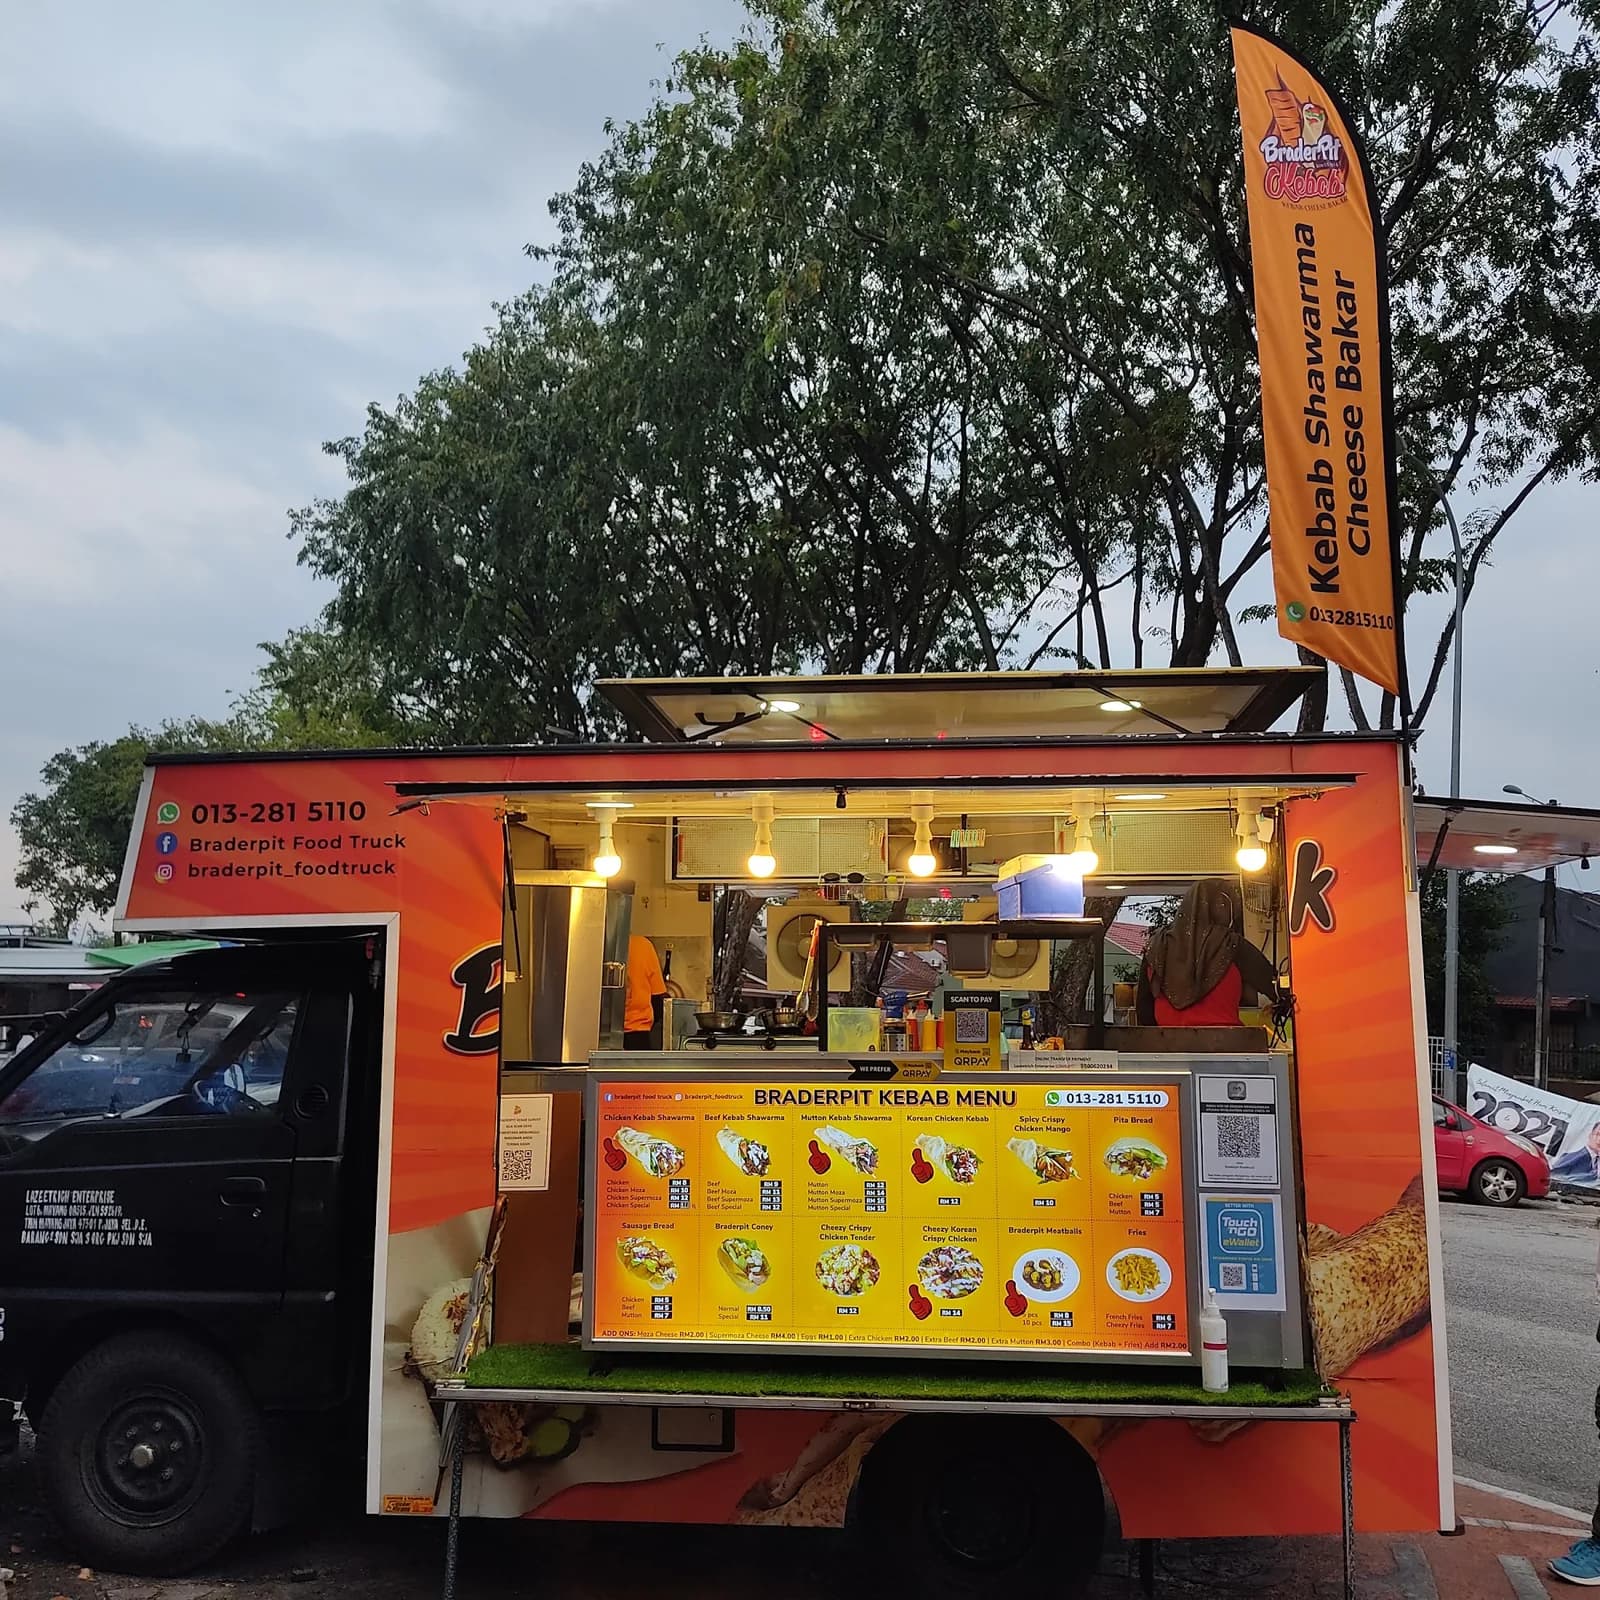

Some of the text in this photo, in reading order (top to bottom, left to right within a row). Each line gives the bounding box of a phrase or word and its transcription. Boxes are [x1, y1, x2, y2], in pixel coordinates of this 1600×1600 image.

[1295, 222, 1339, 593] Kebab Shawarma
[1332, 269, 1371, 556] Cheese Bakar
[1310, 606, 1393, 630] 0132815110
[191, 801, 366, 824] 013-281 5110
[190, 834, 406, 853] Braderpit Food Truck
[188, 860, 395, 879] braderpit_foodtruck
[954, 1057, 990, 1067] QRPAY
[903, 1069, 931, 1078] QRPAY
[754, 1089, 1017, 1106] BRADERPIT KEBAB MENU
[1066, 1093, 1161, 1105] 013-281 5110
[1019, 1116, 1065, 1124] Spicy Crispy
[1472, 1091, 1569, 1157] 2021
[1046, 1126, 1071, 1134] Mango
[715, 1223, 749, 1231] Braderpit
[1222, 1217, 1257, 1227] Touch
[848, 1224, 872, 1232] Crispy
[1008, 1227, 1045, 1235] Braderpit
[922, 1235, 945, 1243] Crispy
[1223, 1238, 1260, 1246] eWallet
